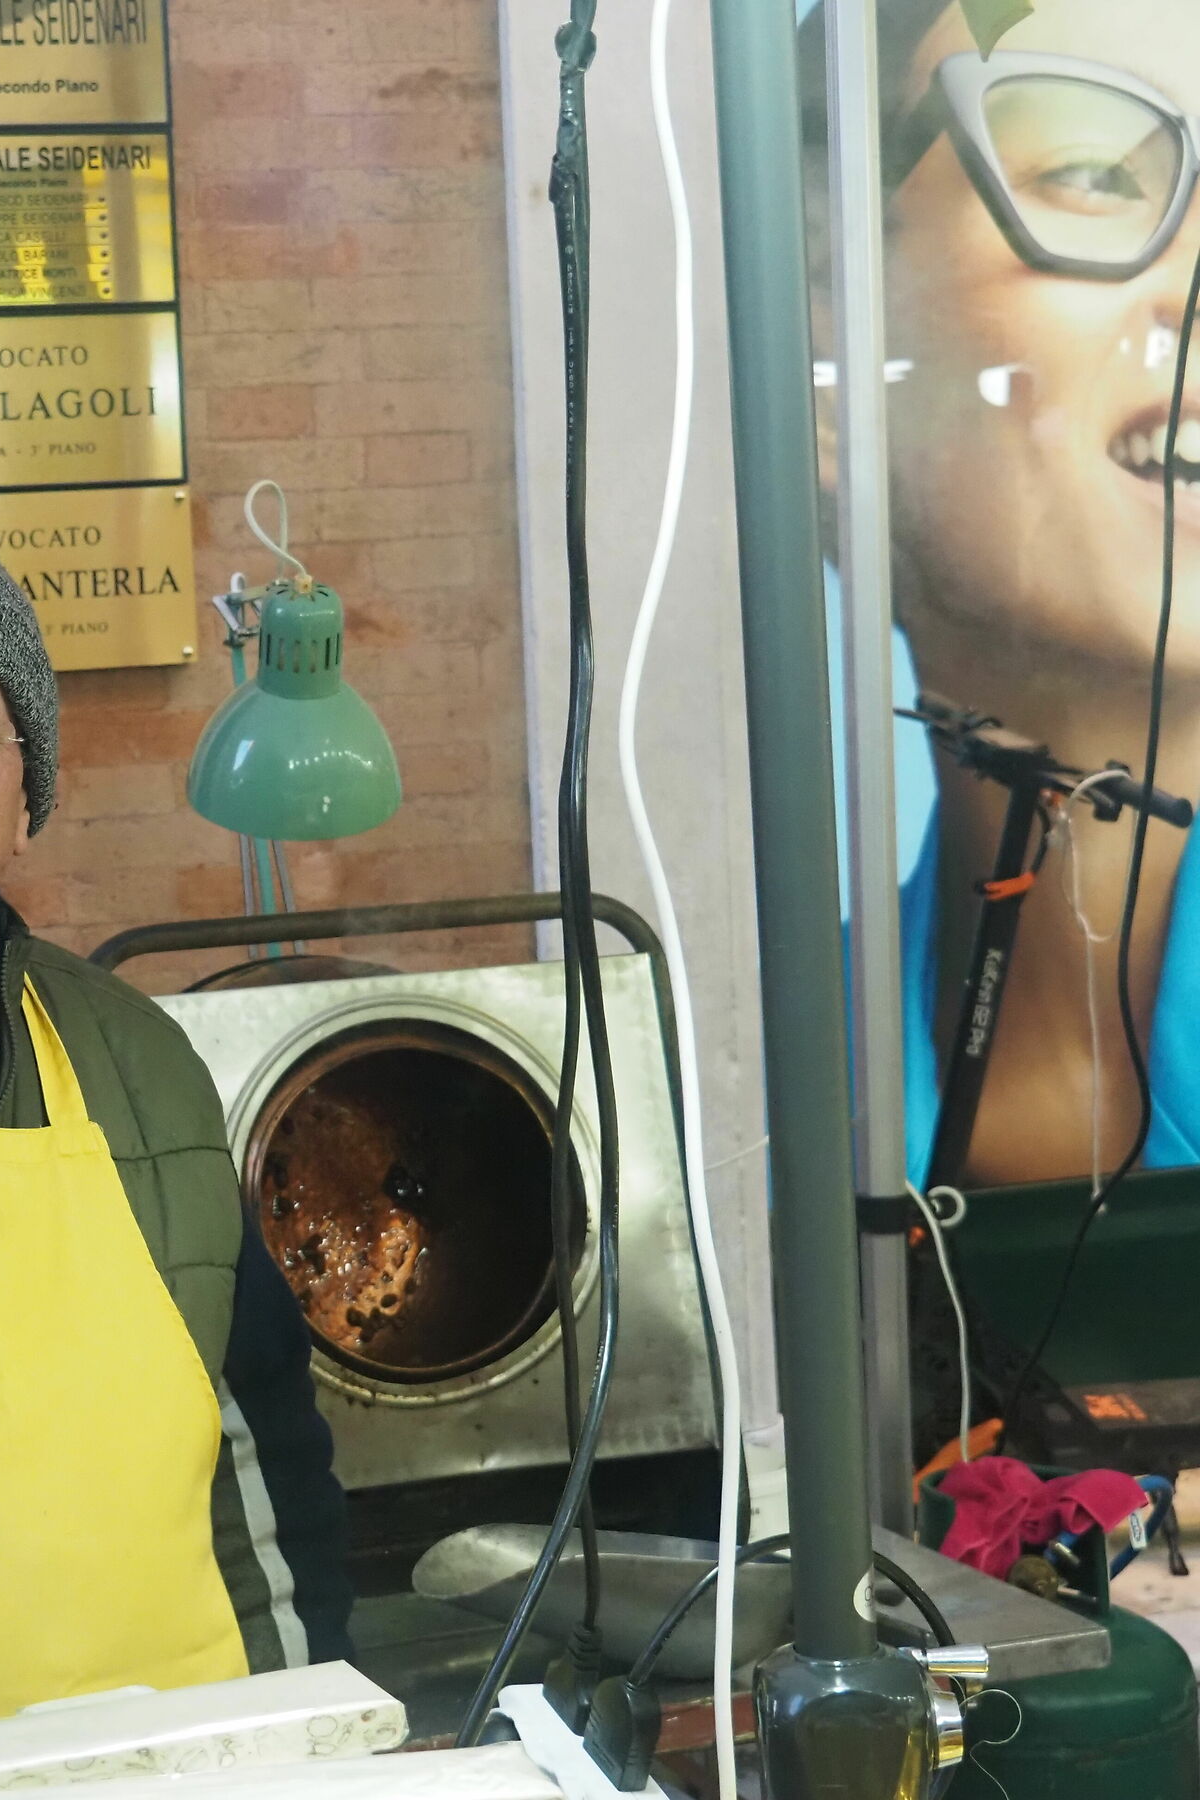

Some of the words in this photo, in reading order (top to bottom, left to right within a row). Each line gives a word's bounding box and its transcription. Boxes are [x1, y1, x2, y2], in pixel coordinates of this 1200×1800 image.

[32, 0, 148, 45] SEIDENARI
[56, 79, 99, 93] Piano
[38, 145, 151, 172] SEIDENARI
[48, 442, 97, 456] PIANO
[18, 565, 181, 601] ANTERLA
[60, 621, 109, 636] PIANO
